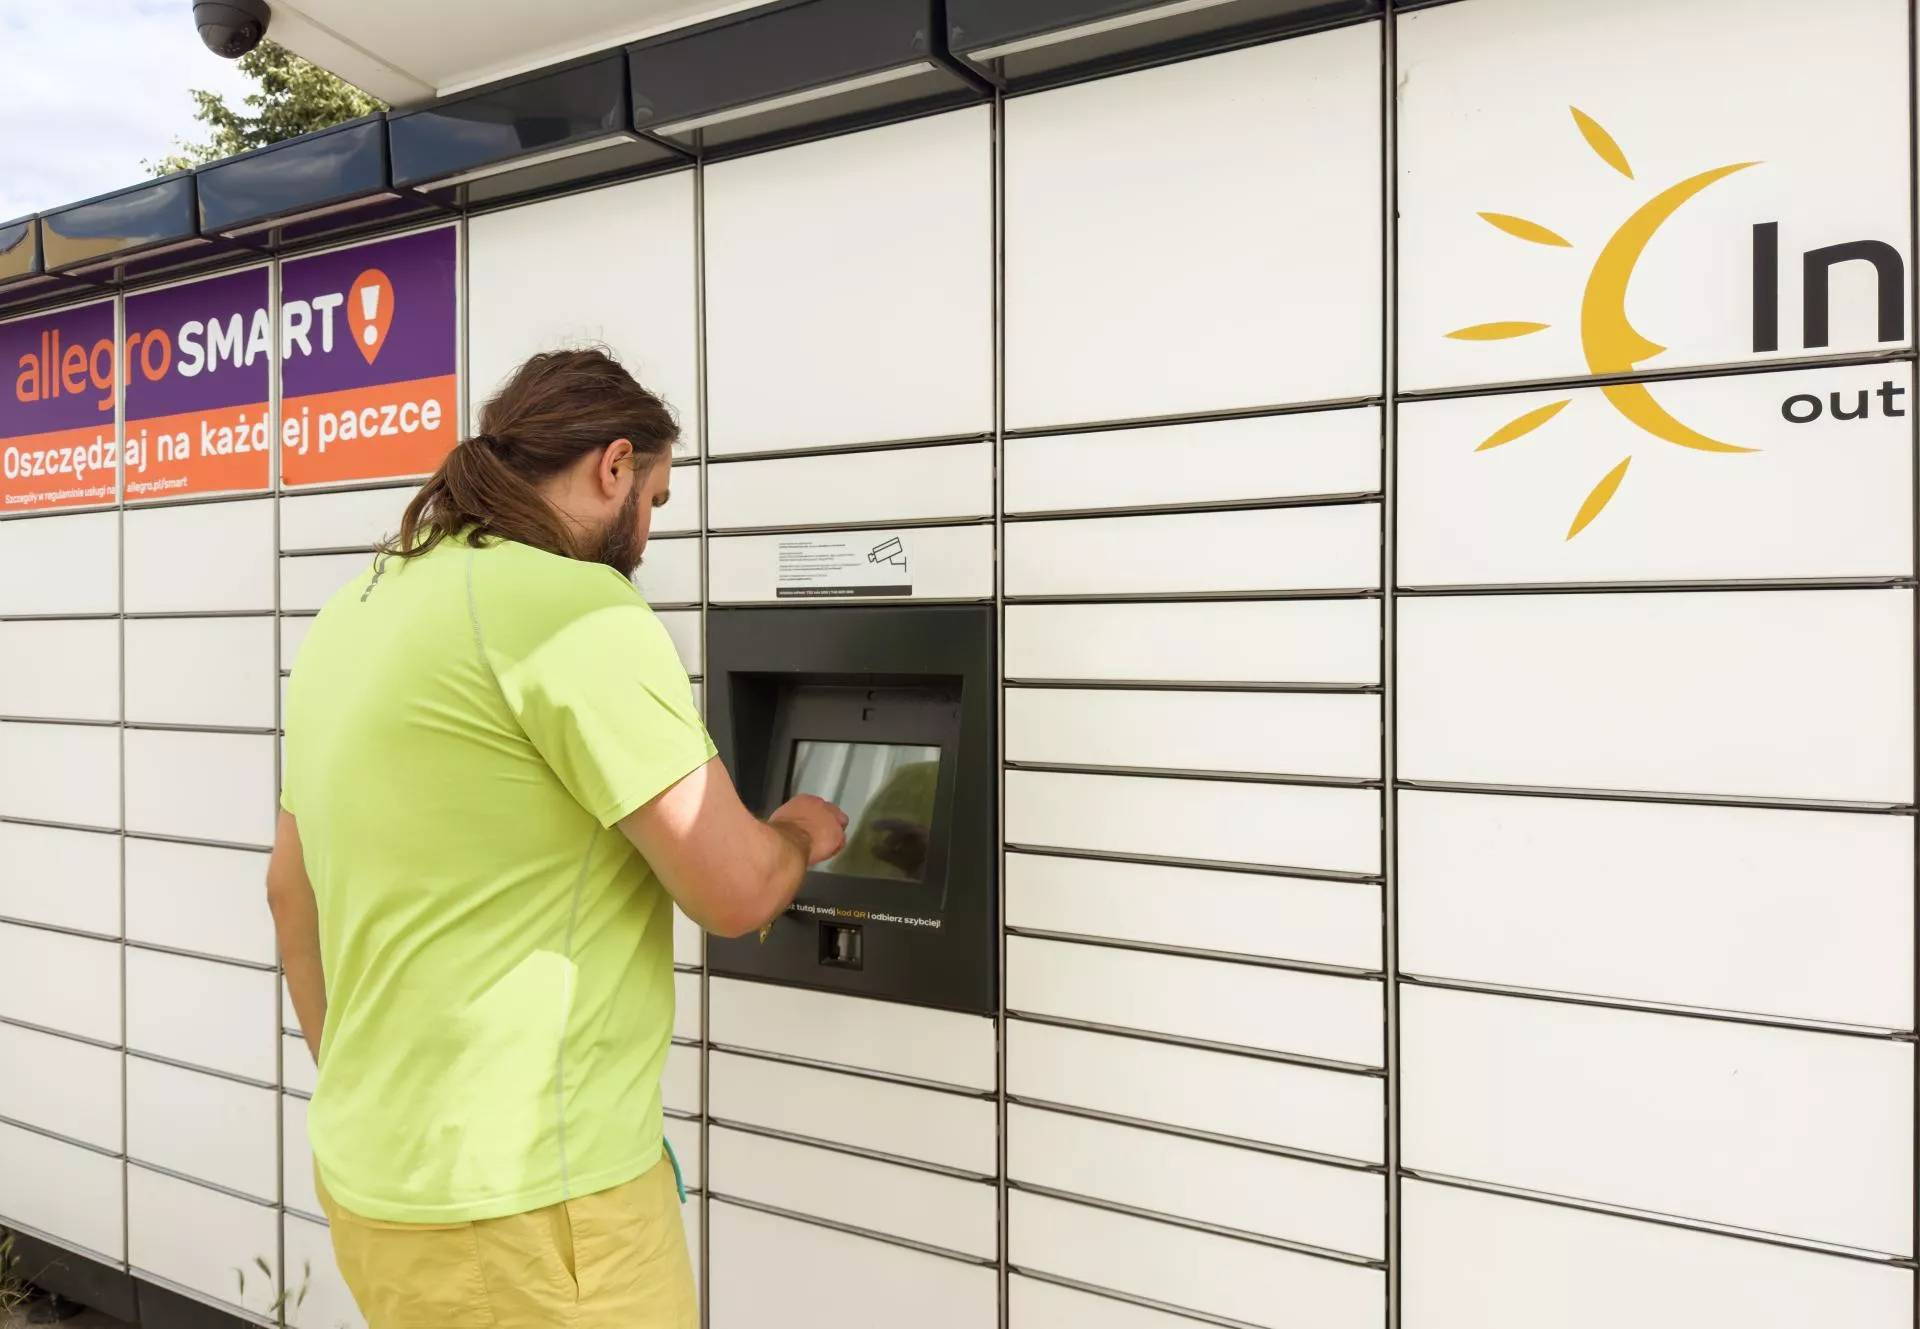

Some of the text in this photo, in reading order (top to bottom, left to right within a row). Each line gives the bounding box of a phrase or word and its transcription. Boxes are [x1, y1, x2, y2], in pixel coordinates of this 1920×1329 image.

[1753, 221, 1905, 353] In
[16, 329, 172, 411] allegro
[177, 292, 344, 378] SMART
[4, 399, 442, 481] Oszczędzaj na każdej paczce
[1781, 380, 1906, 424] out
[836, 908, 852, 917] kod
[853, 910, 866, 919] QR
[871, 912, 903, 923] odbierz
